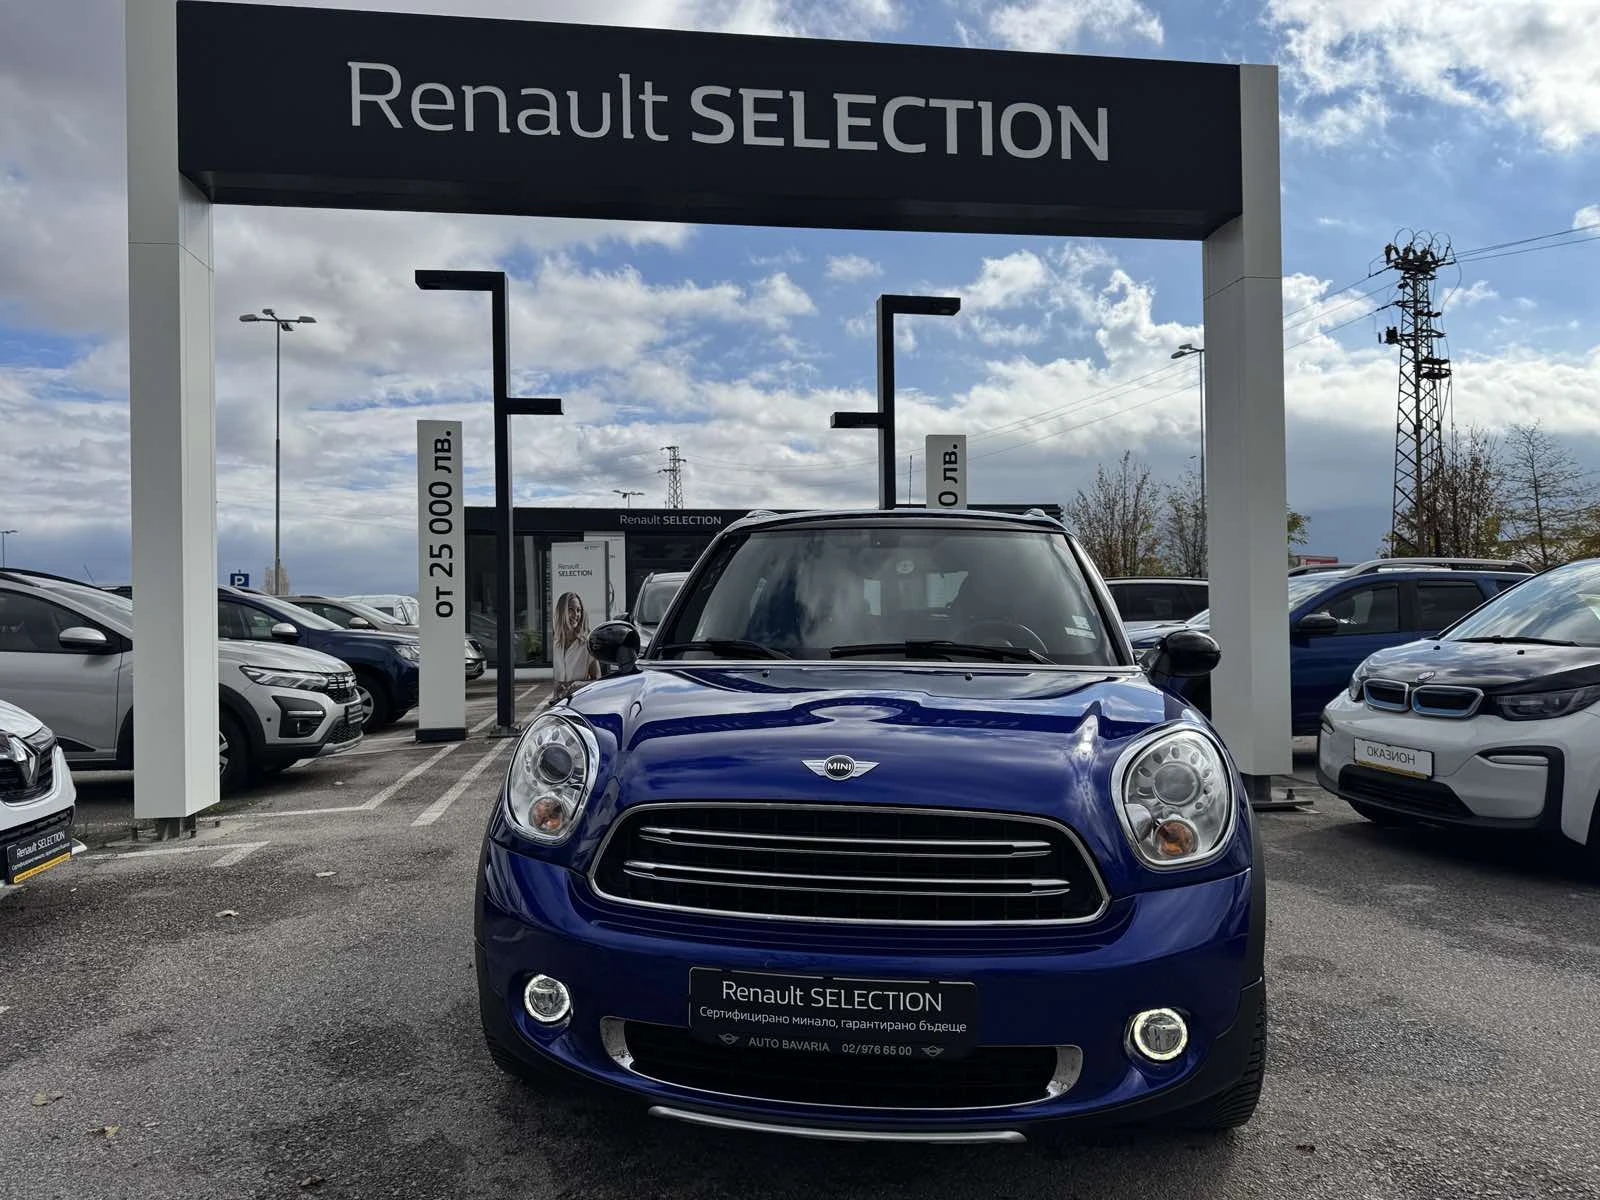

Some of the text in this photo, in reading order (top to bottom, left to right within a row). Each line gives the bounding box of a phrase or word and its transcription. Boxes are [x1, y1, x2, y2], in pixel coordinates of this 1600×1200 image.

[347, 60, 1109, 162] Renault SELECTION
[428, 481, 453, 535] 000
[620, 514, 722, 525] Renault SELECTION
[429, 544, 453, 578] 25
[558, 569, 593, 577] SELECTION
[234, 575, 245, 587] P
[827, 762, 852, 771] MINI
[1366, 745, 1416, 766] ОКАЗИОН
[16, 842, 37, 859] Renault
[37, 831, 65, 850] SELECTION
[722, 980, 943, 1012] Renault SELECTION
[699, 1006, 967, 1033] Сертифицирано минало, гарантирано бъдеще
[748, 1037, 780, 1049] AUTO
[782, 1039, 830, 1052] BAVARIA
[841, 1043, 881, 1055] 02/976
[898, 1046, 912, 1056] 00
